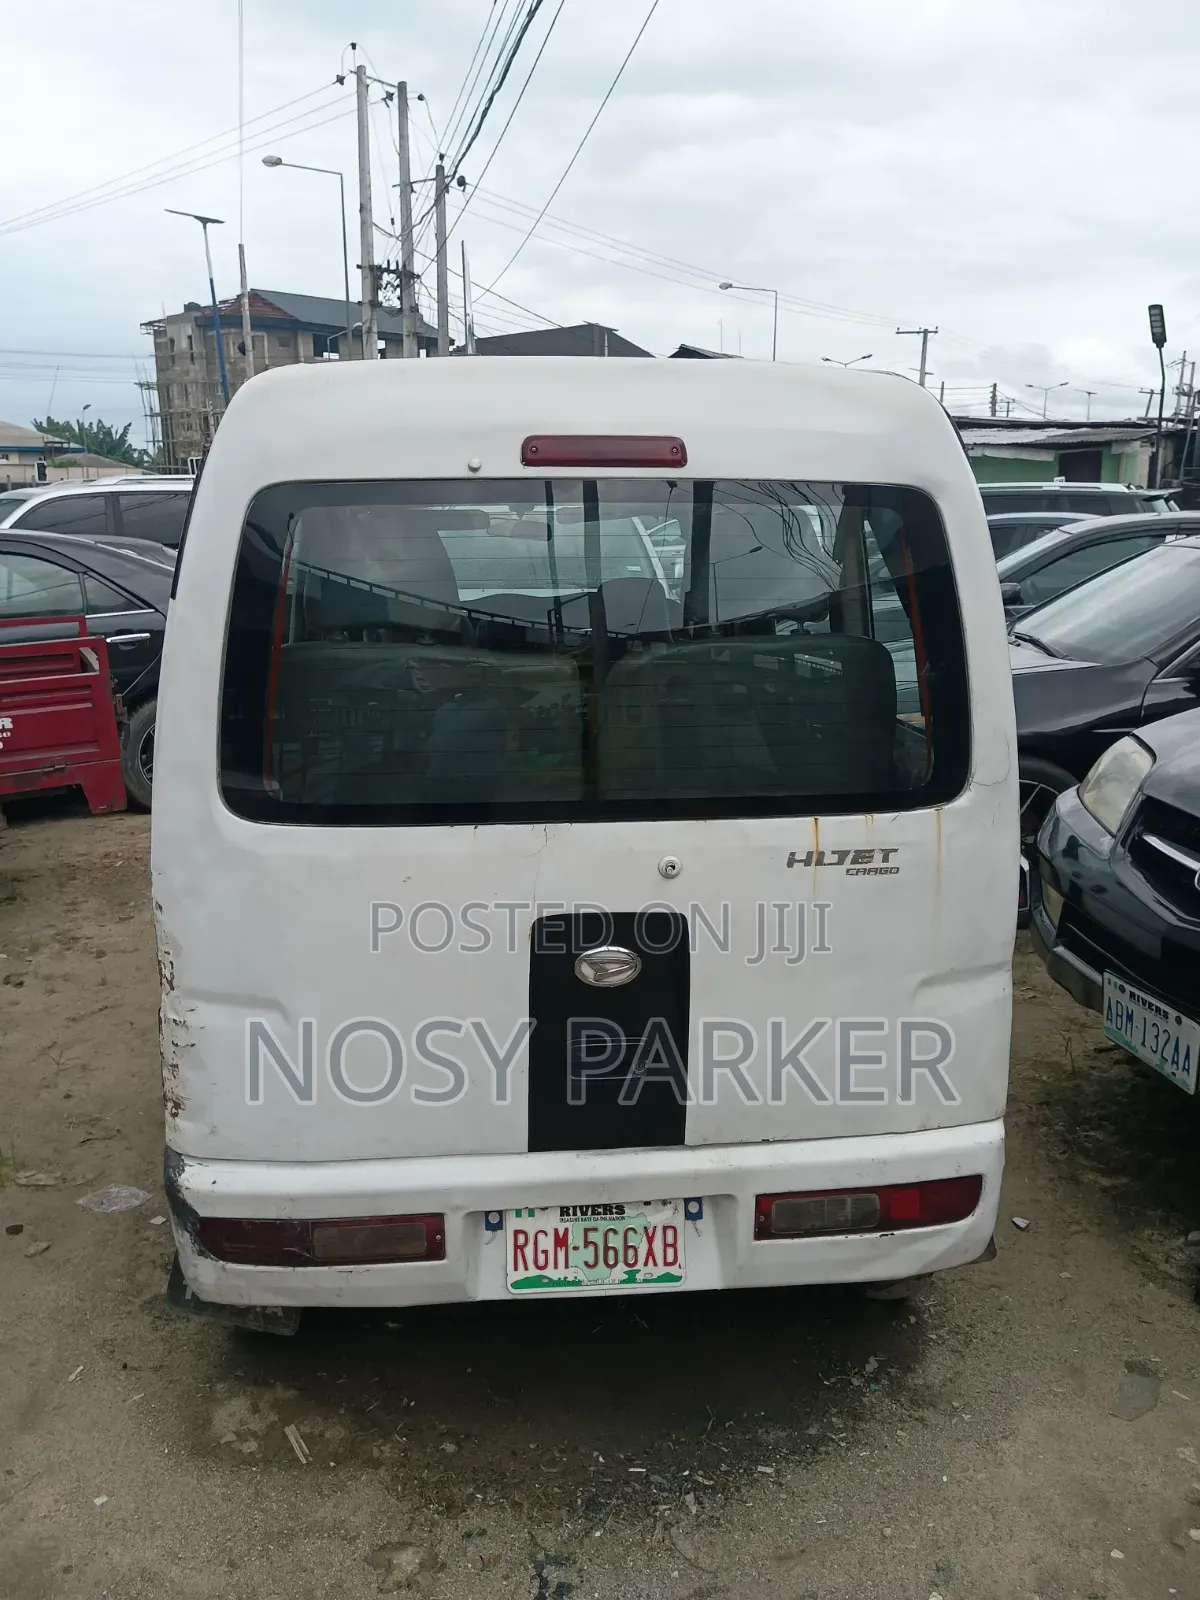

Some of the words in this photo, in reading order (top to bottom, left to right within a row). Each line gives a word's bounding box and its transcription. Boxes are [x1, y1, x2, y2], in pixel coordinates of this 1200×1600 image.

[786, 848, 899, 868] HIJET
[845, 866, 900, 876] CARGO
[1128, 990, 1170, 1020] RIVERS
[1105, 995, 1191, 1076] ABM-132AA
[559, 1204, 626, 1217] RIVERS
[513, 1225, 680, 1271] RGM-566XB
